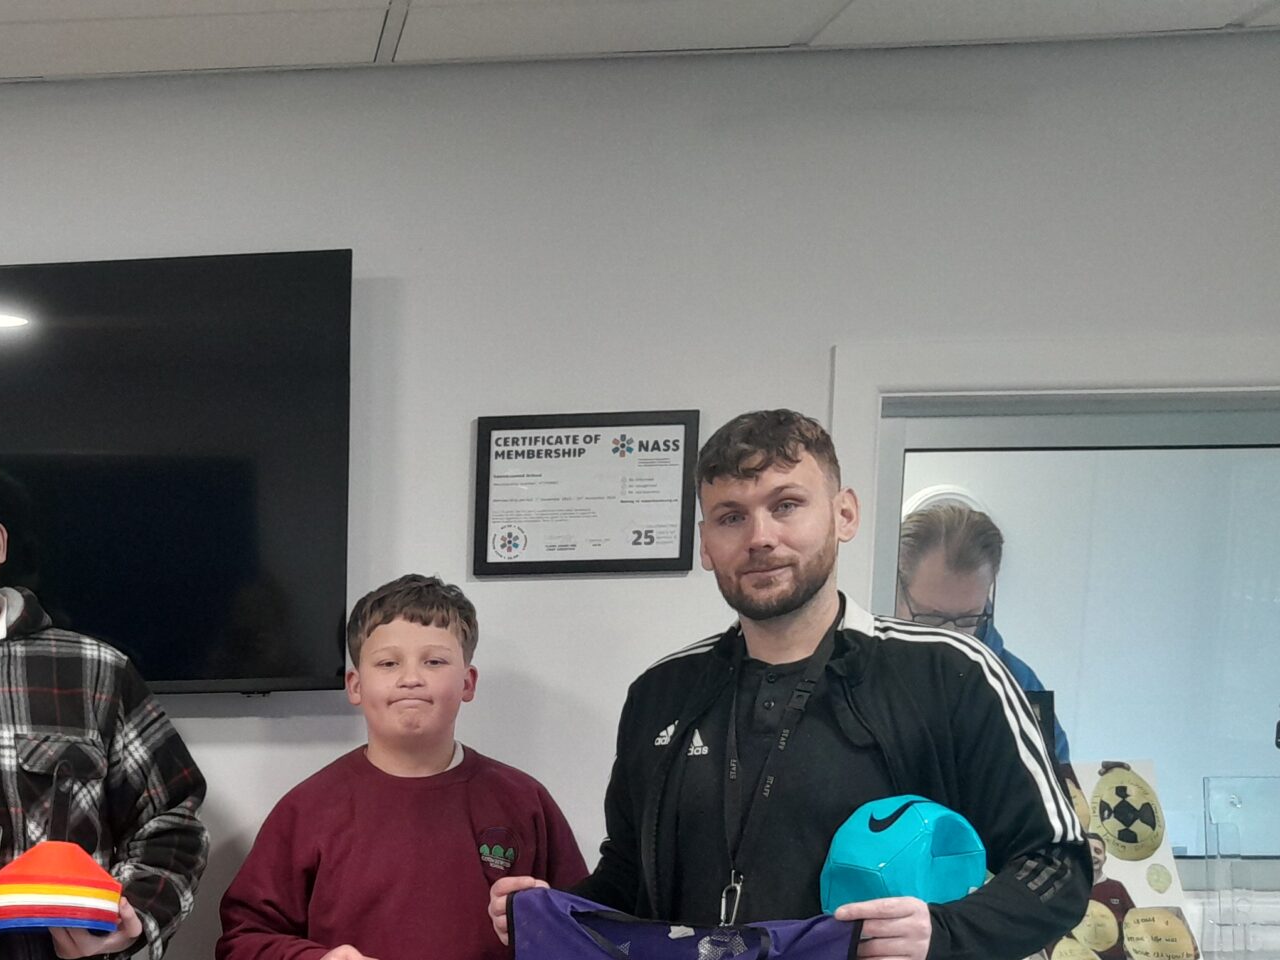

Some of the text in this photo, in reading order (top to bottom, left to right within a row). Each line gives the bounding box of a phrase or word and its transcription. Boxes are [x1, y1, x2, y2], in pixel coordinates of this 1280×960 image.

[494, 434, 601, 447] CERTIFICATE OF
[638, 439, 680, 453] NASS
[494, 448, 586, 460] MEMBERSHIP
[631, 529, 655, 546] 25
